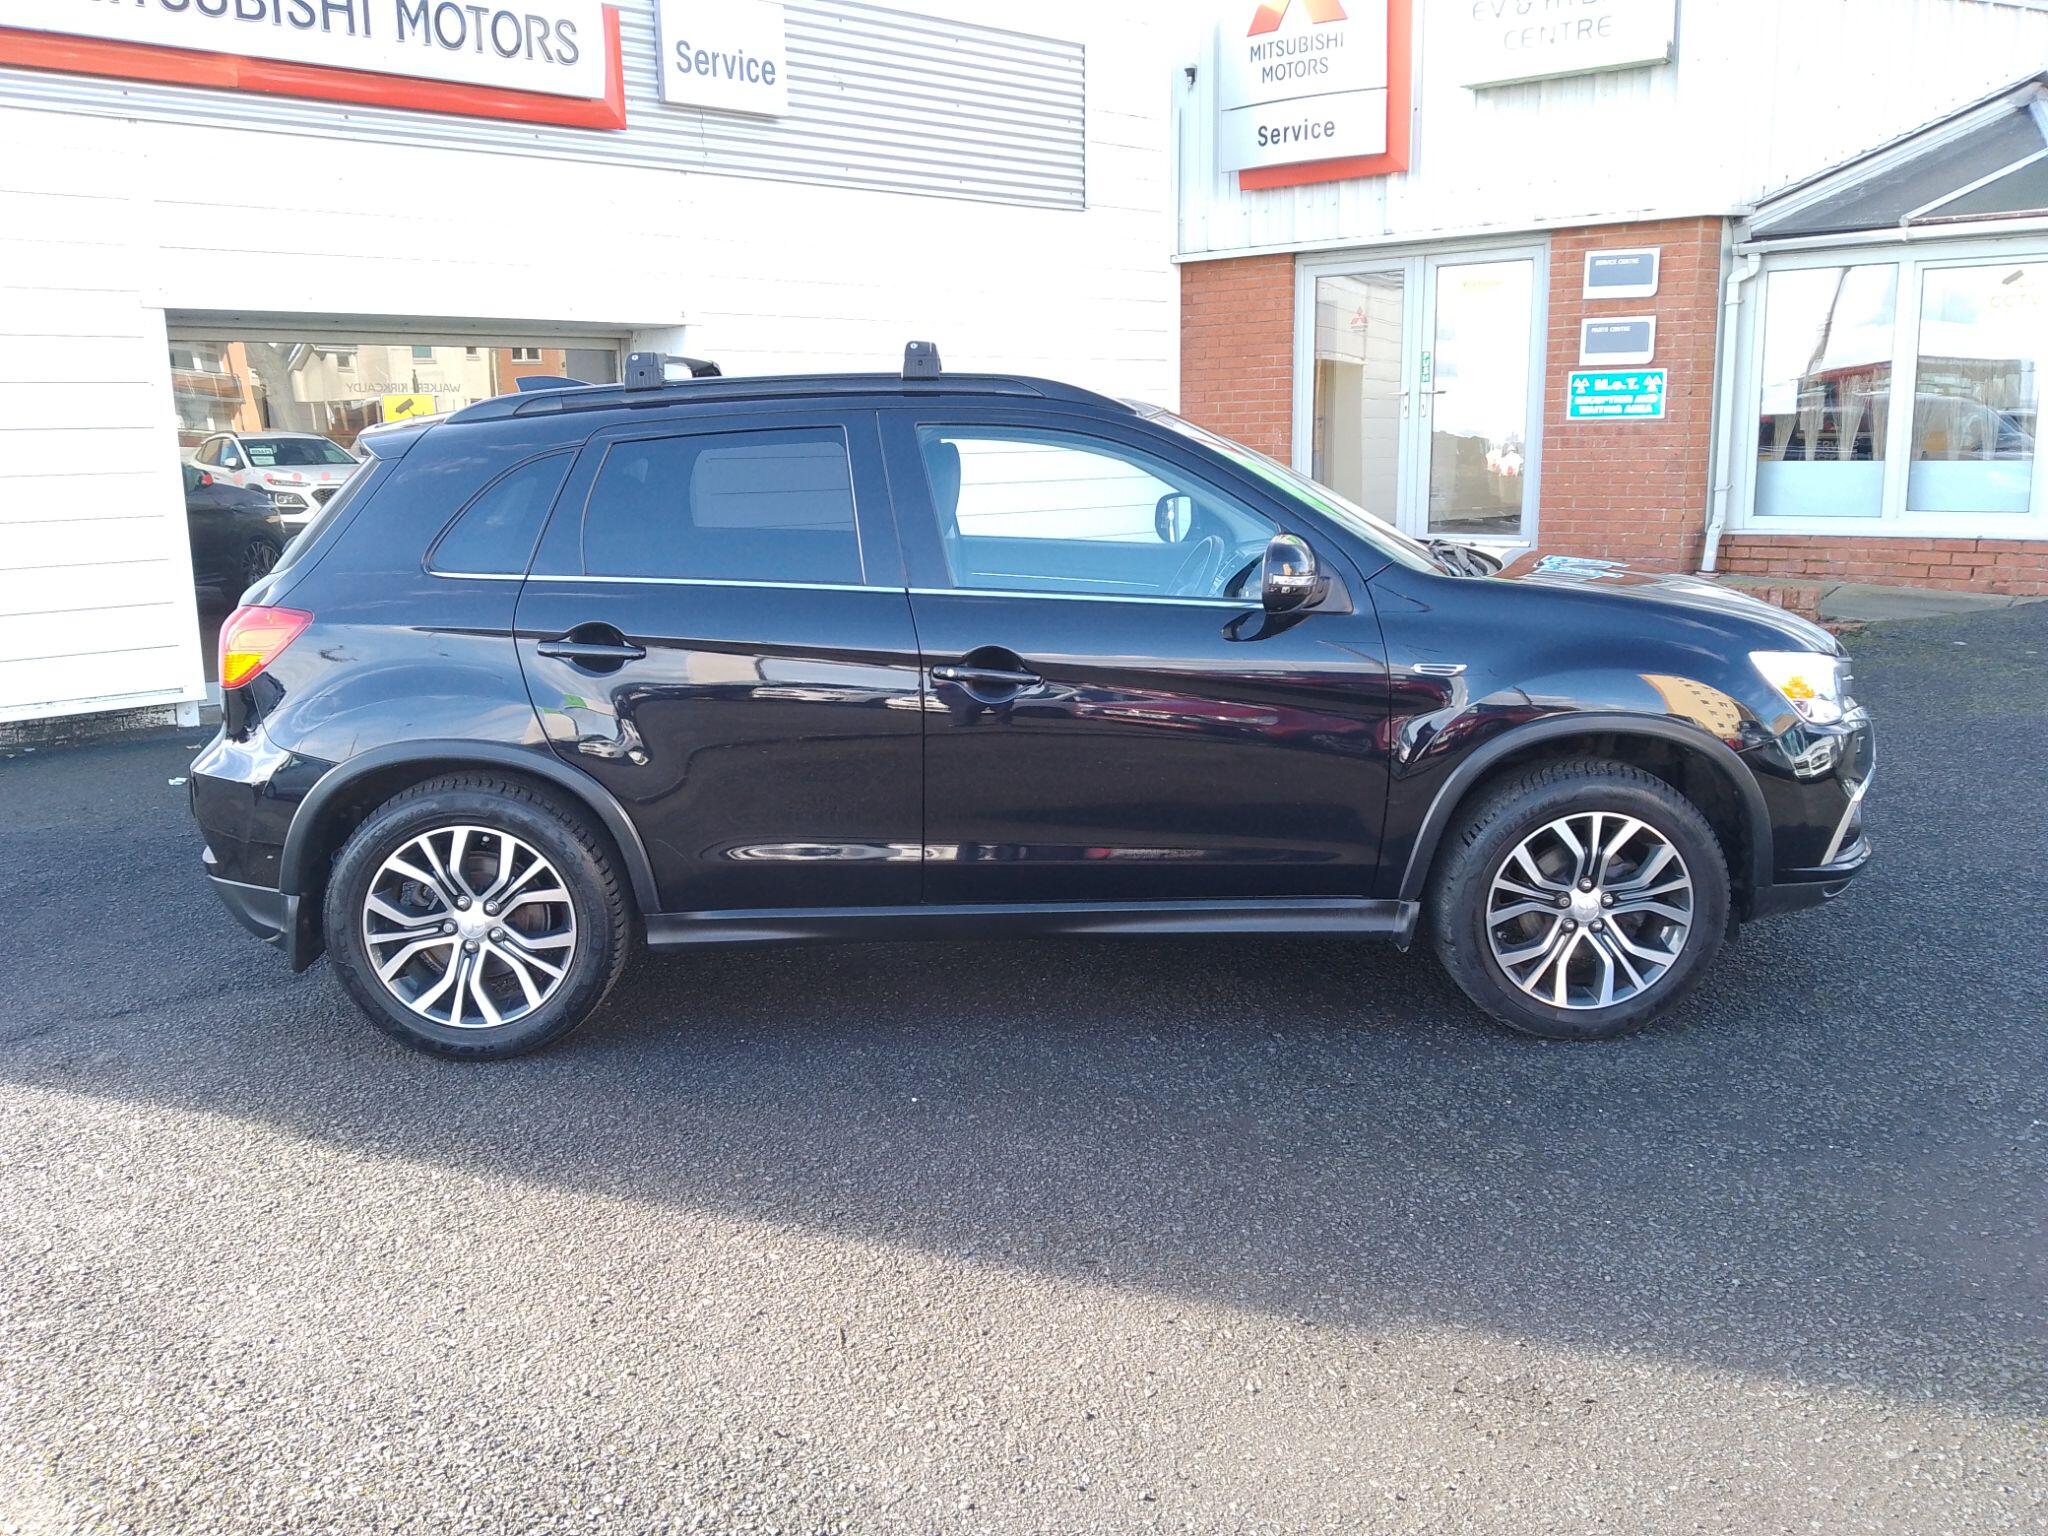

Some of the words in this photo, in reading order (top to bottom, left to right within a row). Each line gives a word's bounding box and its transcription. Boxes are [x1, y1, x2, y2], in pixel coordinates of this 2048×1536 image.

[394, 0, 580, 66] MOTORS
[1250, 32, 1344, 63] MITSUBISHI
[1503, 14, 1613, 51] CENTRE
[676, 40, 776, 85] Service
[1262, 56, 1329, 84] MOTORS
[1257, 118, 1335, 147] Service
